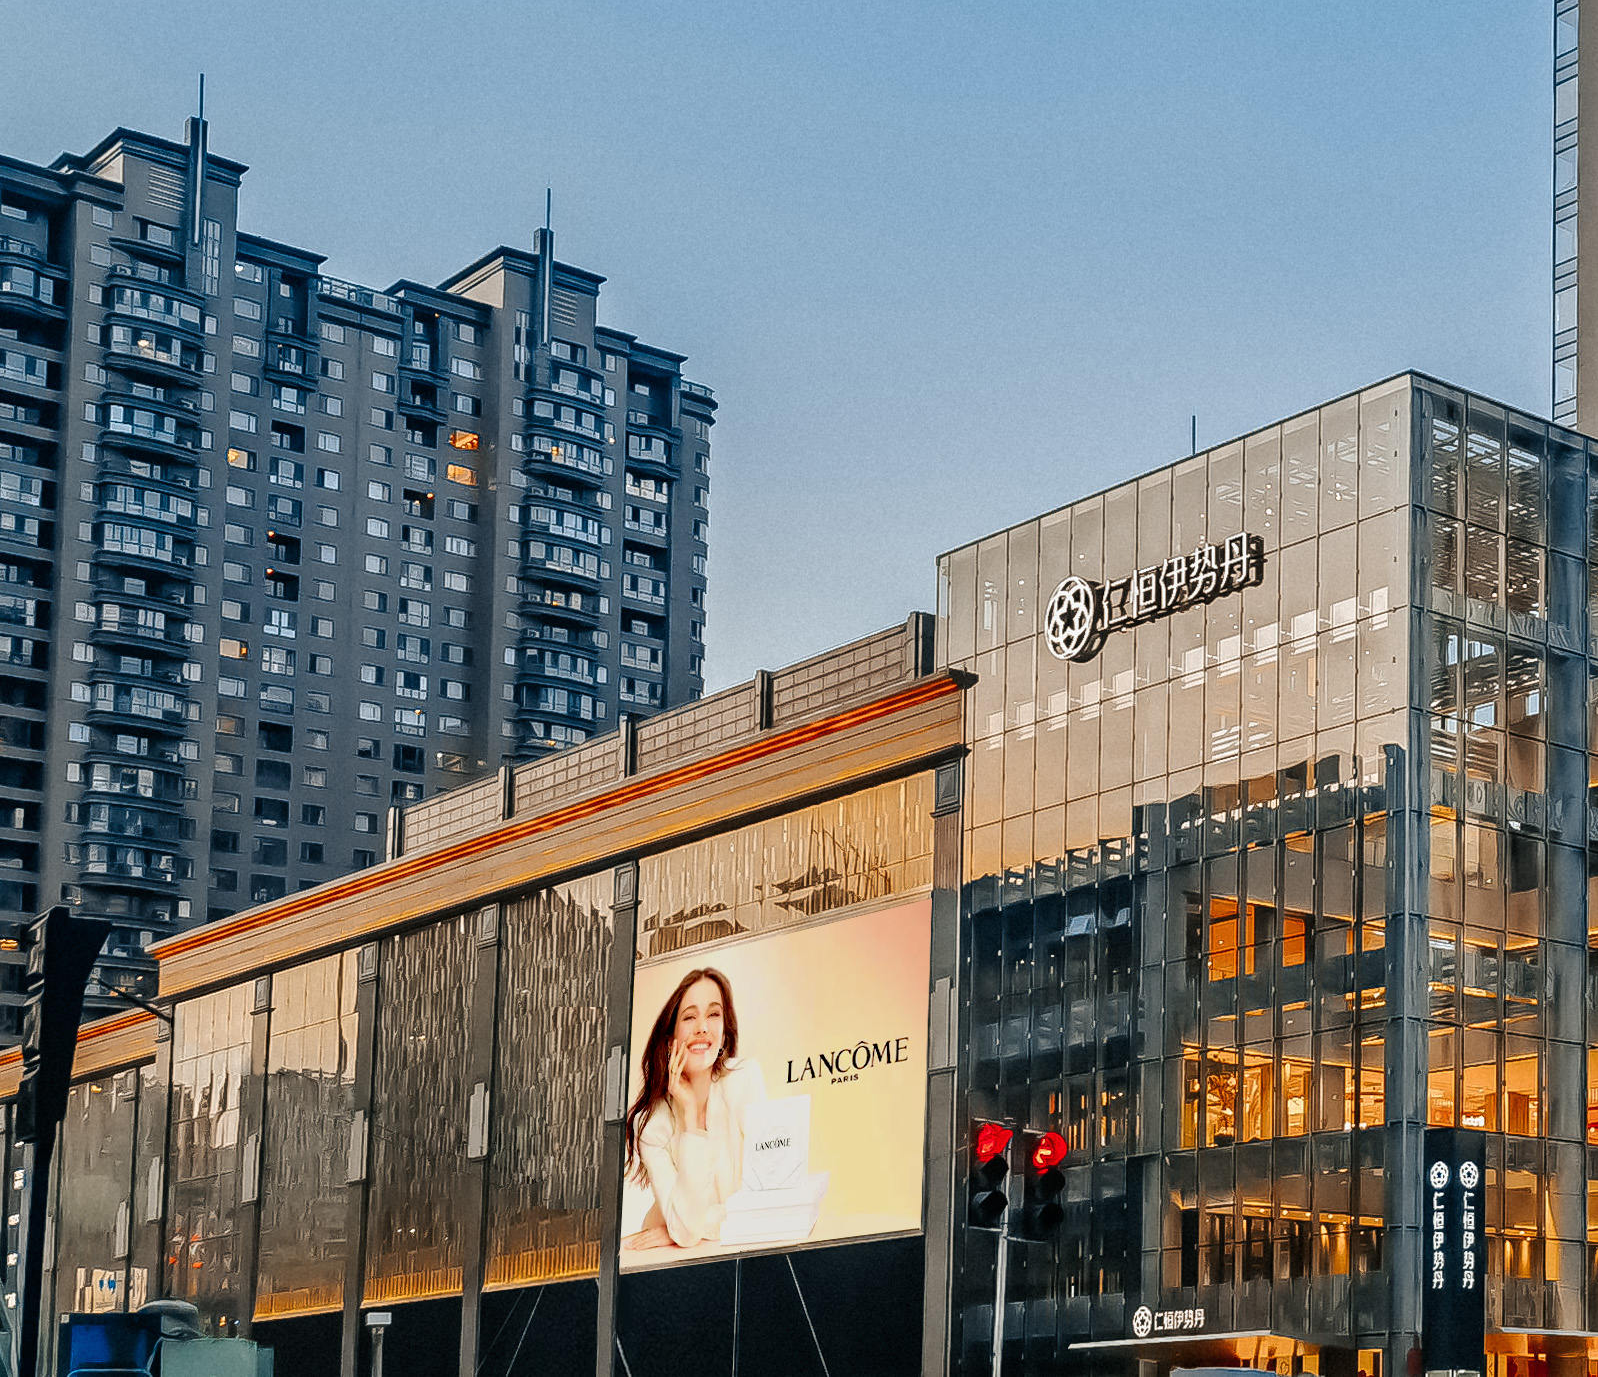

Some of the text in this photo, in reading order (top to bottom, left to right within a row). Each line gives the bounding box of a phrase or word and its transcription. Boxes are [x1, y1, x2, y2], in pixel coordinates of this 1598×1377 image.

[1102, 531, 1251, 628] 仁恒伊势丹
[786, 1036, 909, 1084] LANCÔME
[830, 1073, 860, 1085] PARIS
[755, 1137, 791, 1152] LANCÔME
[1154, 1308, 1205, 1331] 仁恒伊势丹
